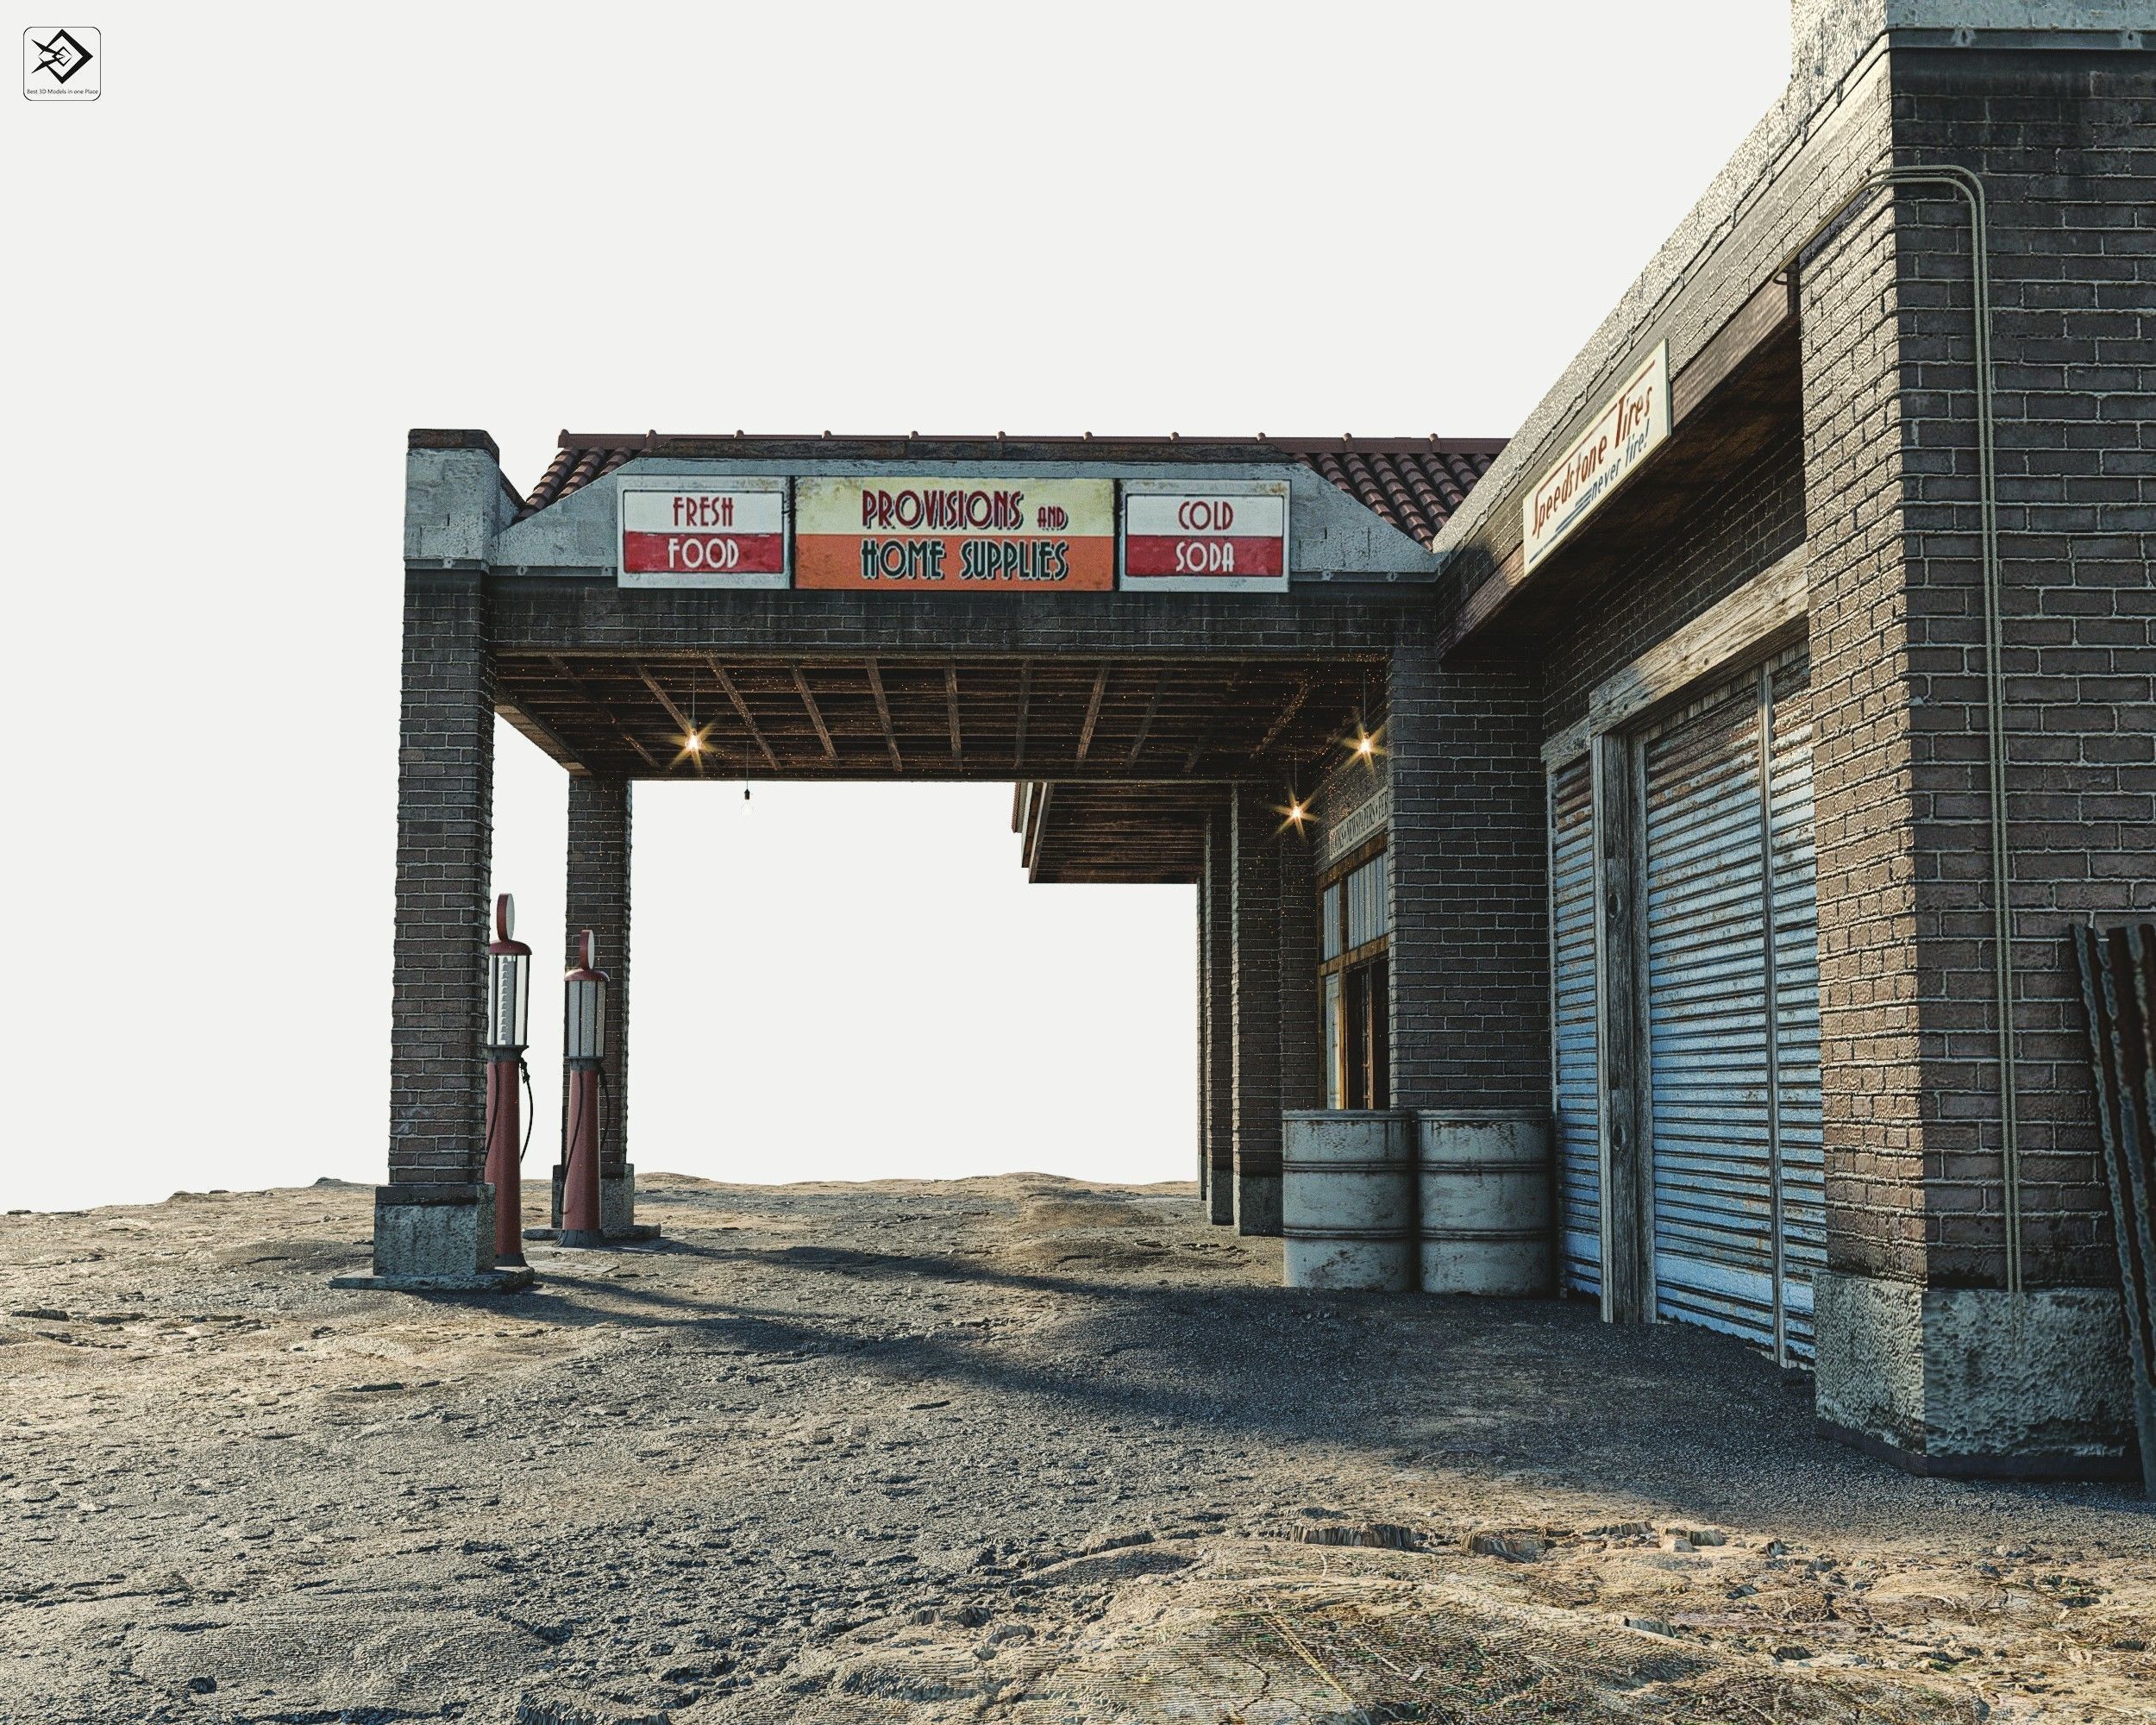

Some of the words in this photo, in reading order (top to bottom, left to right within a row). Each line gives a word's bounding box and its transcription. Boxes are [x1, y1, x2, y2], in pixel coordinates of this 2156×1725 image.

[1532, 435, 1607, 539] Speedstone
[1614, 386, 1652, 449] Tires
[1590, 457, 1621, 501] never
[1625, 417, 1650, 469] tire!
[673, 496, 734, 527] FRESH
[862, 489, 1025, 530] PROVISIONS
[1037, 505, 1069, 530] AND
[1178, 500, 1233, 530] COLD
[667, 537, 739, 569] FOOD
[861, 537, 947, 581] HOME
[959, 538, 1069, 581] SUPPLIES
[1175, 542, 1234, 573] SODA
